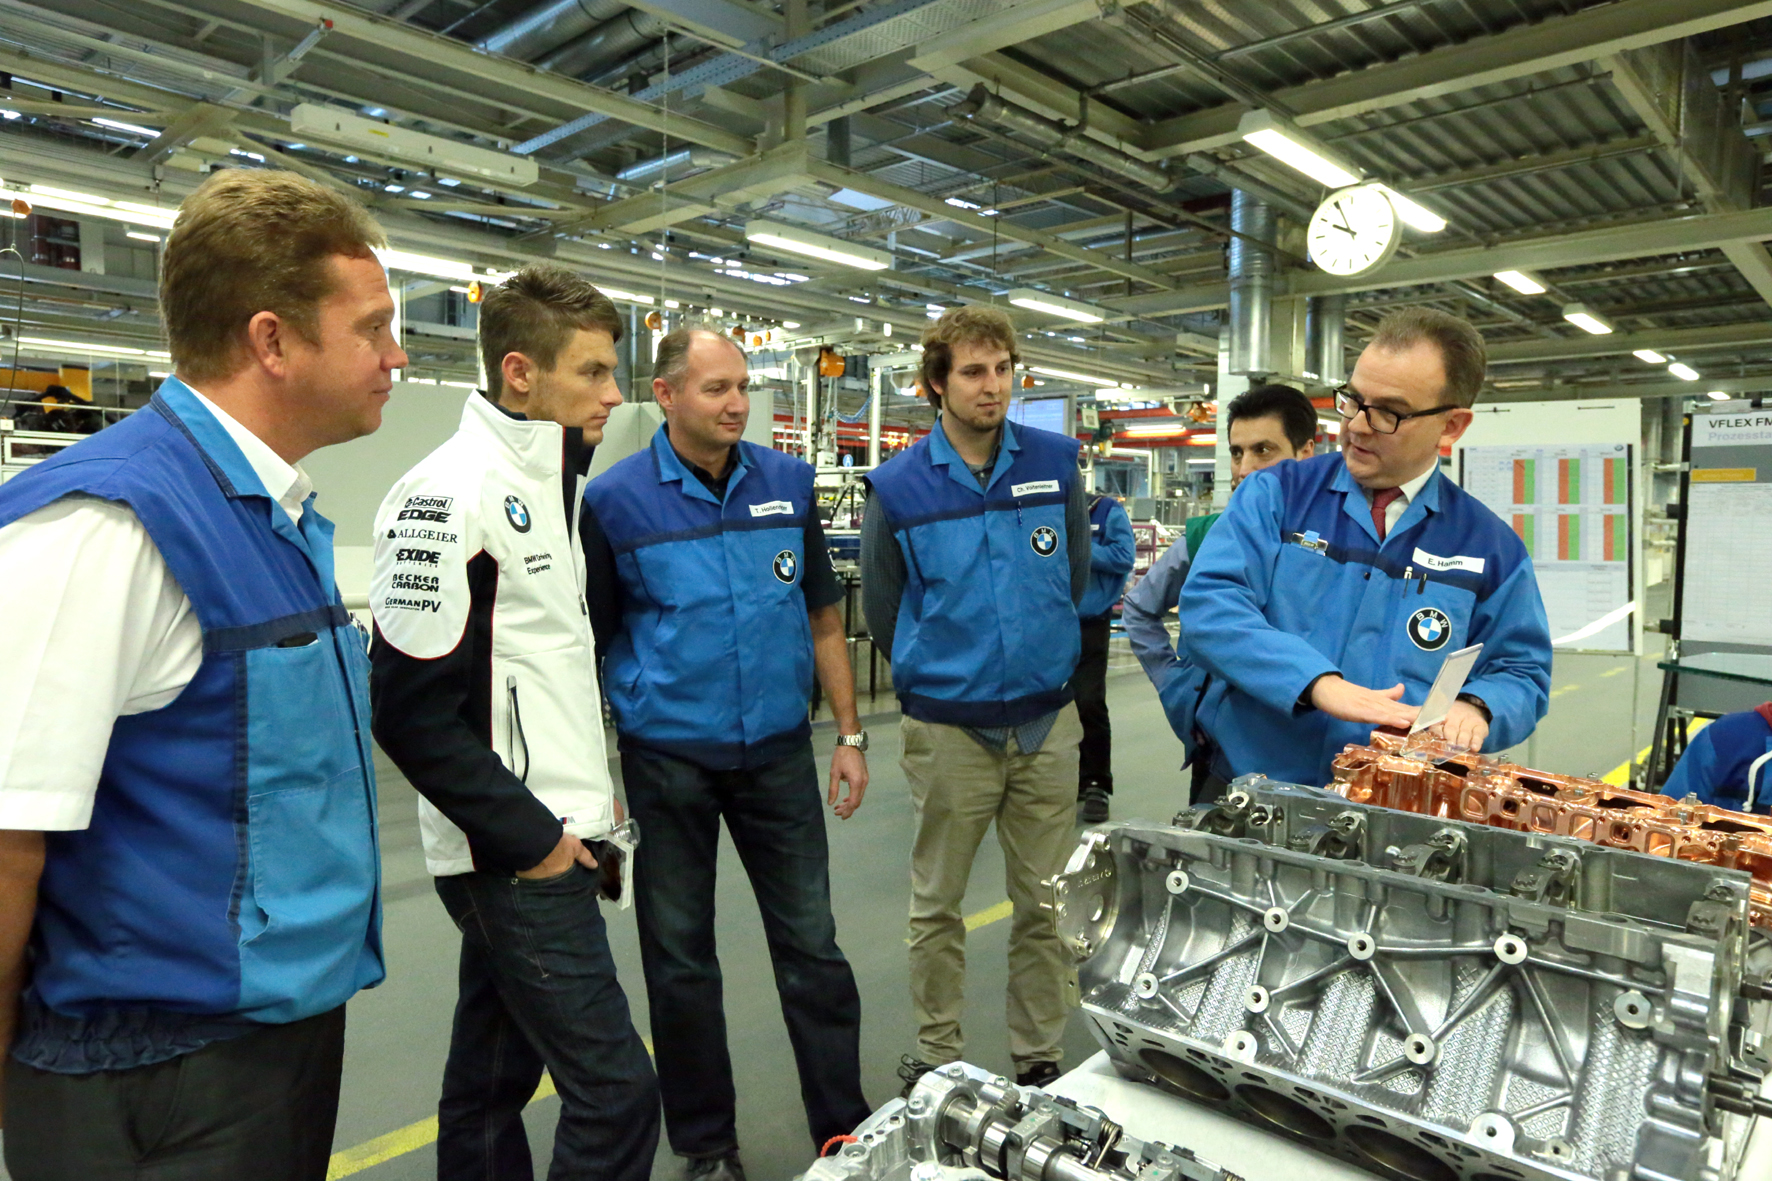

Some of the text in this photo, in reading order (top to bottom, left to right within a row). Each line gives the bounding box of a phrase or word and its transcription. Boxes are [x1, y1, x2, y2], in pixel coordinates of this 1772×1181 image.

[1709, 418, 1752, 429] VFLEX
[412, 497, 447, 508] Castrol
[397, 509, 451, 523] EDGE
[397, 529, 458, 543] ALLGEIER
[396, 549, 441, 563] EXIDE
[392, 574, 439, 584] BECKER
[391, 582, 439, 592] CARBON
